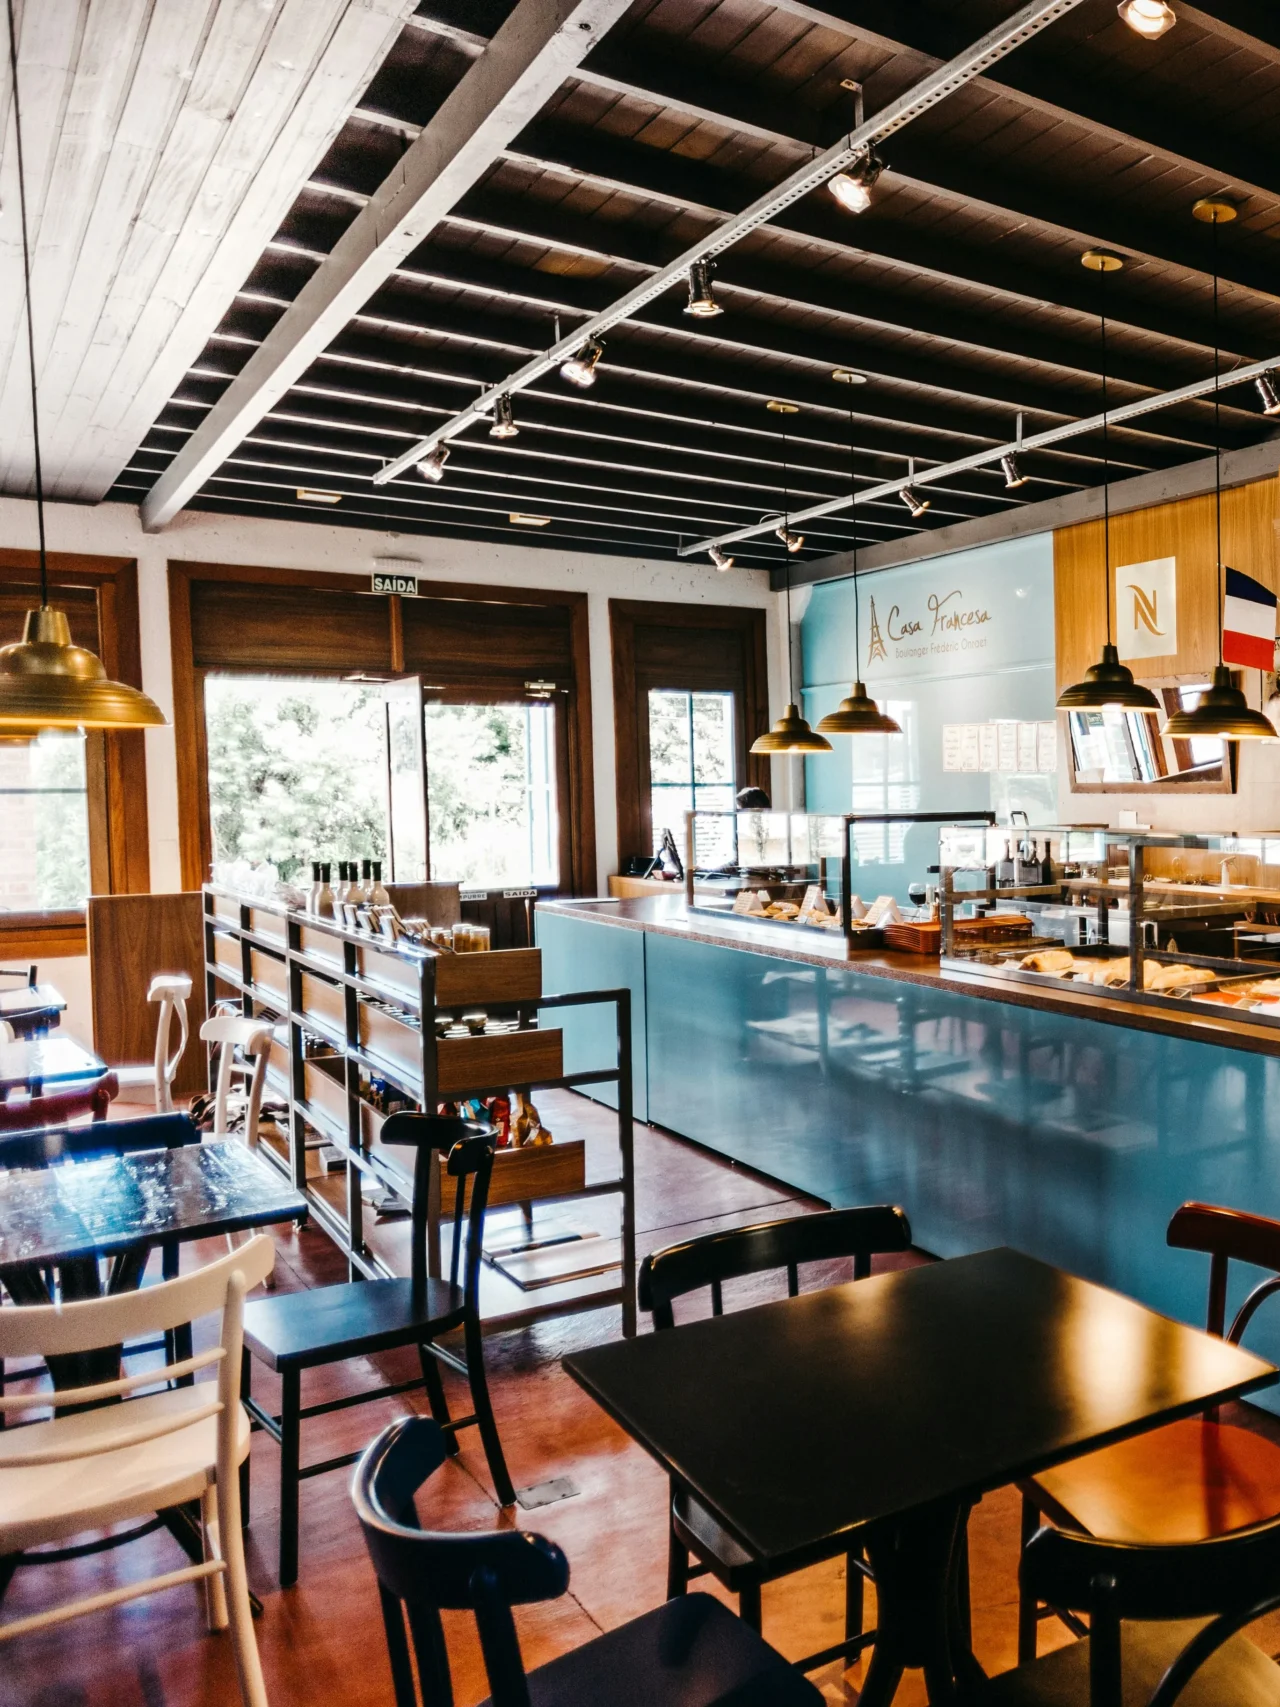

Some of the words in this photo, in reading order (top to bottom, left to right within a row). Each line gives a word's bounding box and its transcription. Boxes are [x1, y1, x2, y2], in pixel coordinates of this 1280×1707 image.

[374, 576, 415, 592] SAÍDA
[888, 605, 923, 641] Casa
[928, 590, 992, 636] Francesa
[1125, 584, 1167, 636] N
[895, 646, 928, 659] Boulanger
[931, 642, 958, 654] Frédéric
